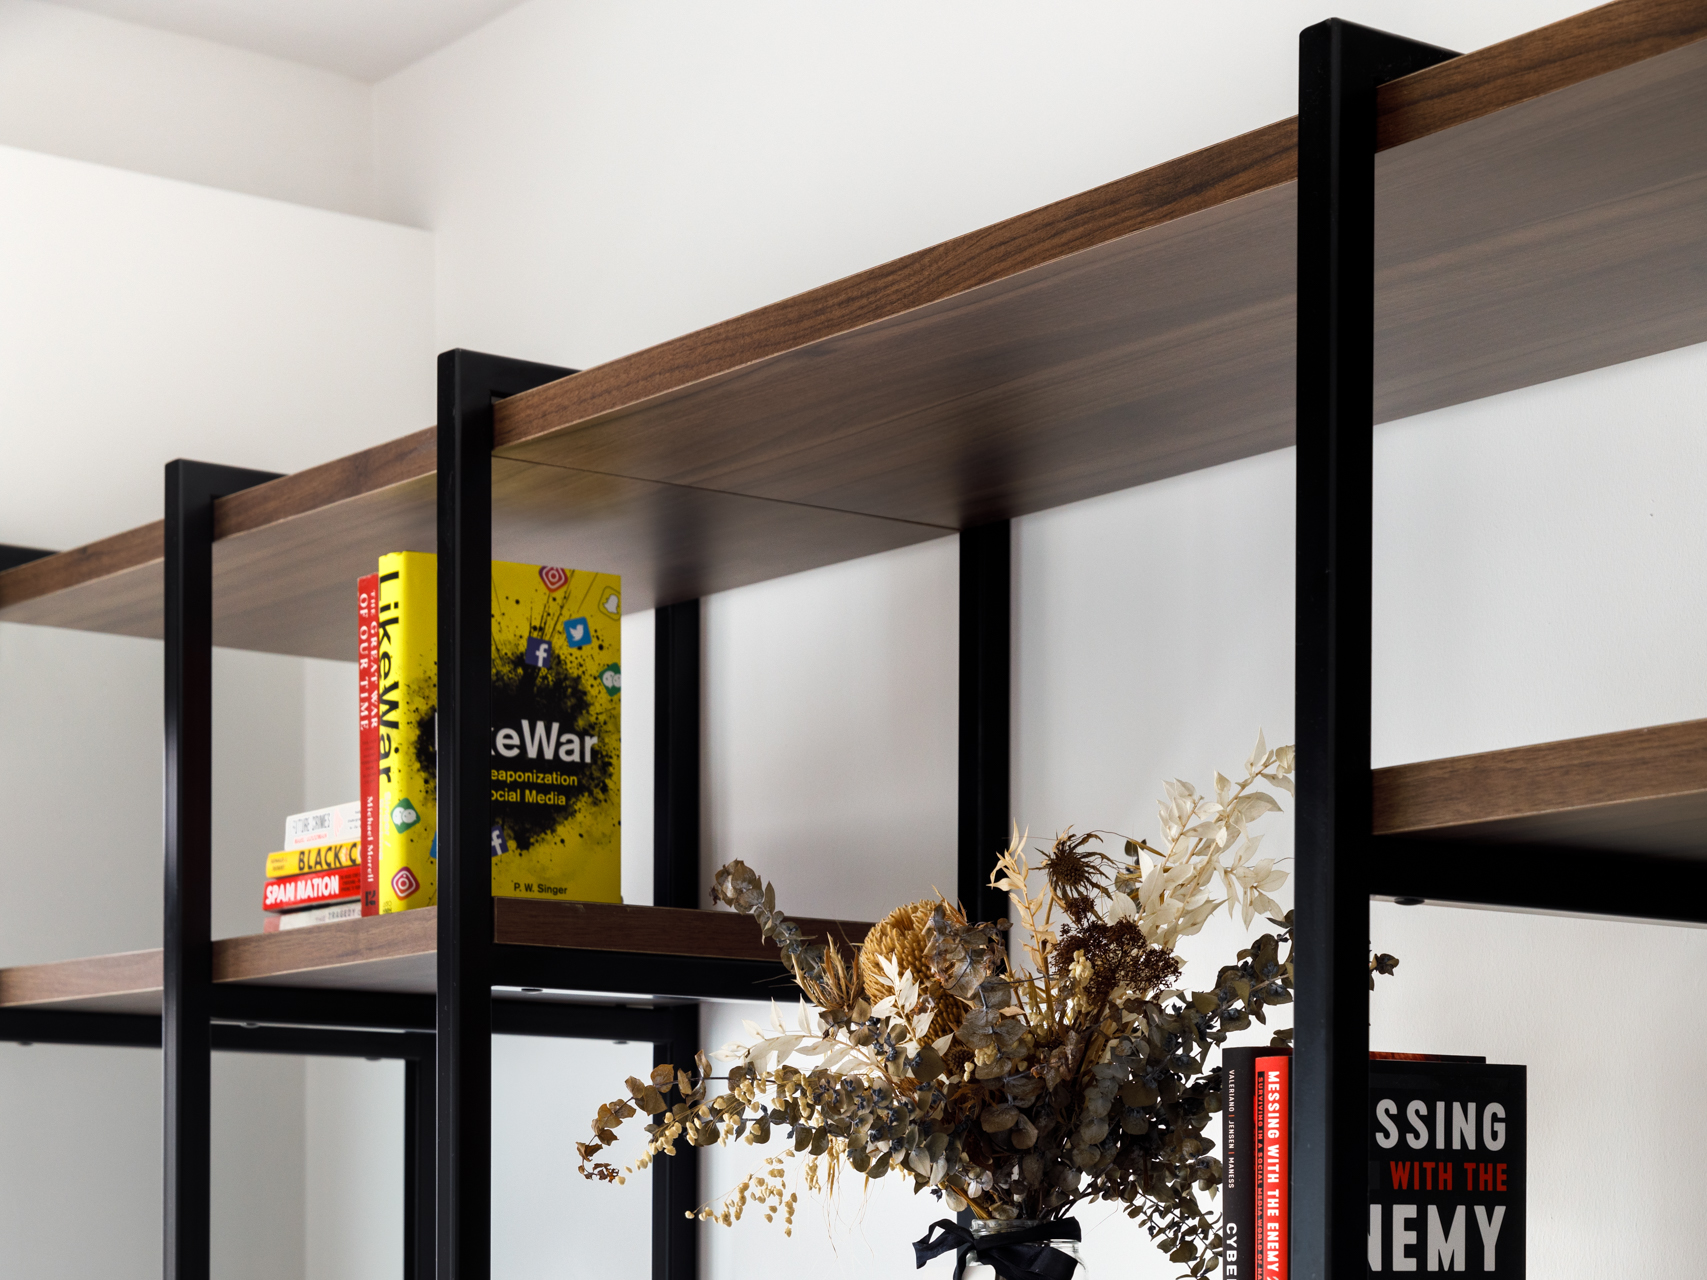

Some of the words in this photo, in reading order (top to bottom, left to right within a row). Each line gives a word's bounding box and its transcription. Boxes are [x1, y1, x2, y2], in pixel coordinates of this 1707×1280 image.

[359, 593, 368, 618] OF
[360, 626, 368, 670] OUR
[379, 570, 399, 784] LikeWar
[360, 676, 369, 730] TIME
[491, 719, 598, 764] eWar
[491, 769, 578, 786] eaponization
[491, 788, 520, 802] ocial
[525, 789, 566, 806] Media
[298, 844, 343, 872] BLACK
[266, 882, 296, 905] SPAM
[297, 874, 340, 900] NATION
[514, 882, 522, 892] P.
[524, 883, 535, 893] W.
[537, 884, 568, 896] Singer
[328, 908, 356, 920] TRAGEDY
[1267, 1070, 1280, 1139] MESSING
[1258, 1130, 1263, 1140] IN
[1375, 1098, 1506, 1152] SSING
[1267, 1144, 1280, 1183] WITH
[1390, 1160, 1452, 1190] WITH
[1464, 1162, 1507, 1192] THE
[1267, 1189, 1280, 1217] THE
[1267, 1222, 1280, 1272] ENEMY
[1368, 1204, 1506, 1272] EMY
[1257, 1253, 1262, 1265] OF
